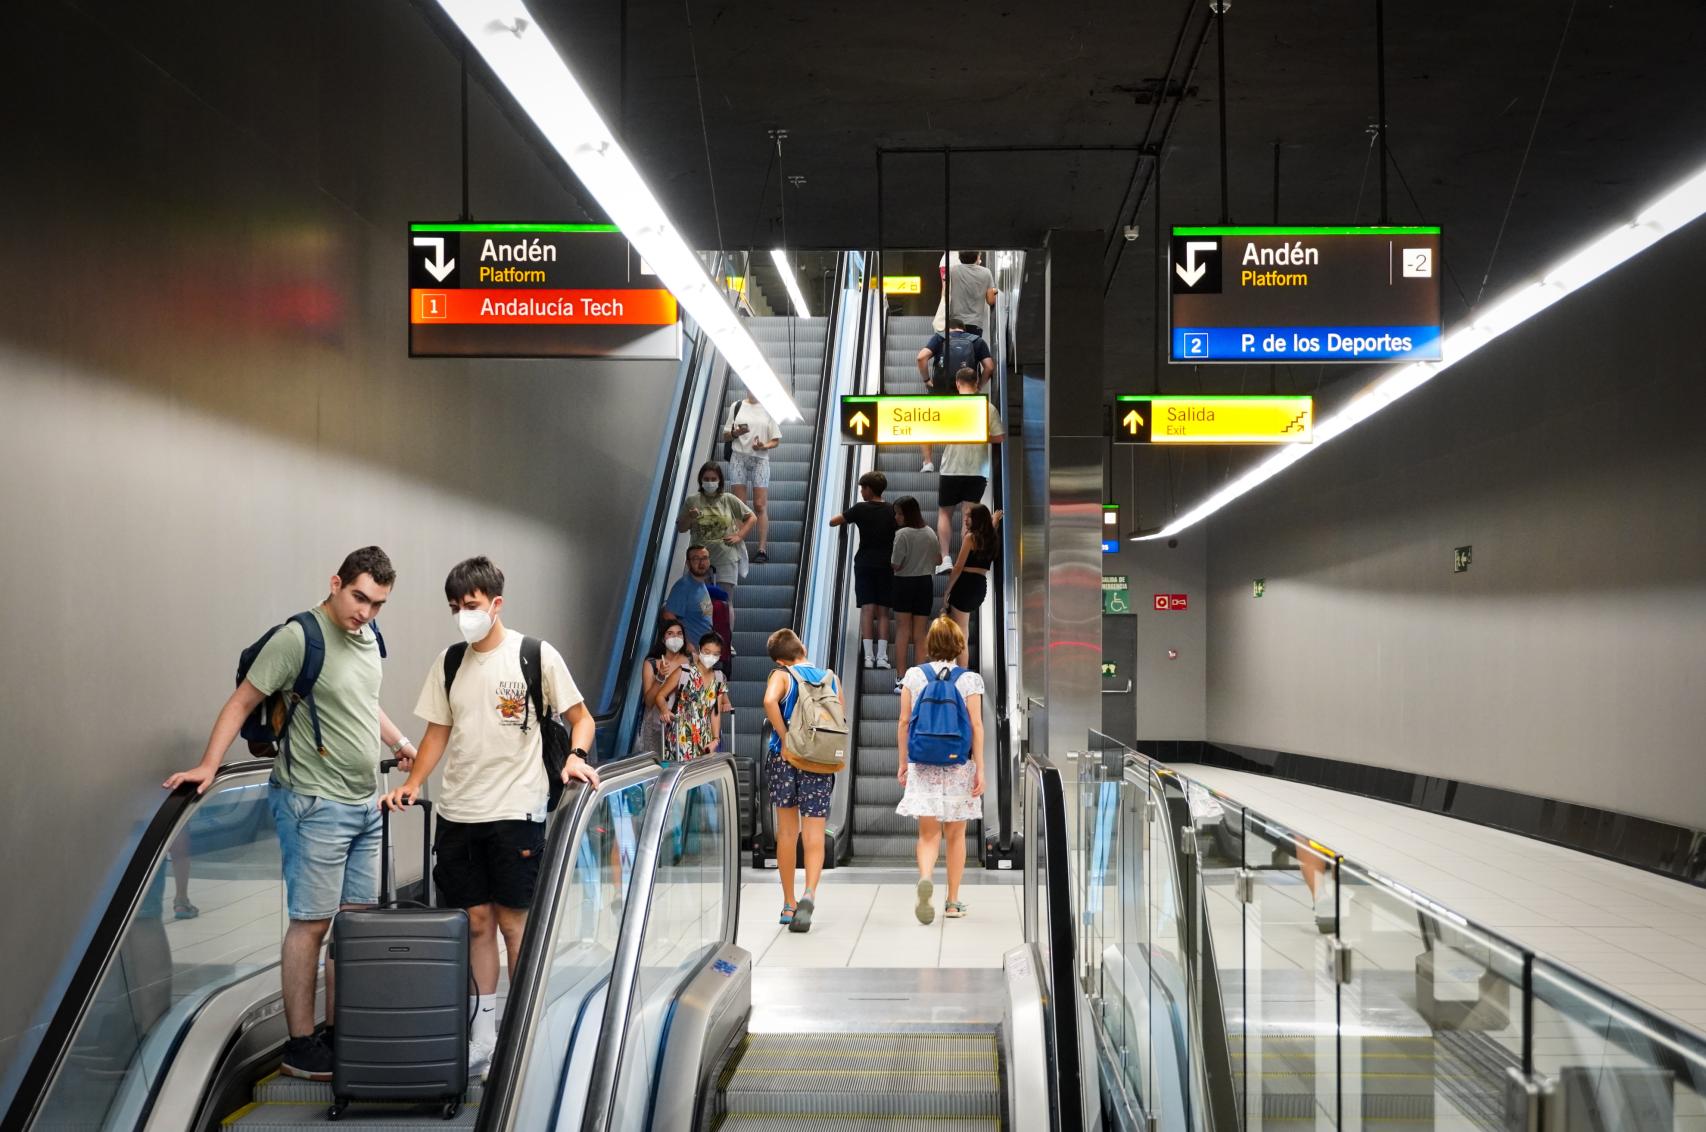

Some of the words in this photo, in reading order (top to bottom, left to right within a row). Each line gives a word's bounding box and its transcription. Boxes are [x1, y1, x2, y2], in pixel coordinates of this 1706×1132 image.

[480, 238, 557, 262] Andén
[1242, 242, 1319, 266] Andén
[1407, 254, 1427, 272] -2
[480, 266, 546, 283] Platform
[1241, 270, 1308, 286] Platform
[430, 299, 438, 314] 1
[480, 297, 574, 317] Andalucía
[580, 297, 623, 316] Tech
[1191, 338, 1202, 353] 2
[1241, 333, 1255, 352] P.
[1263, 334, 1287, 352] de
[1294, 334, 1320, 352] los
[1327, 334, 1412, 355] Deportes
[893, 408, 941, 422] Salida
[1167, 407, 1215, 422] Salida
[893, 426, 911, 435] Exit
[1167, 426, 1185, 435] Exit
